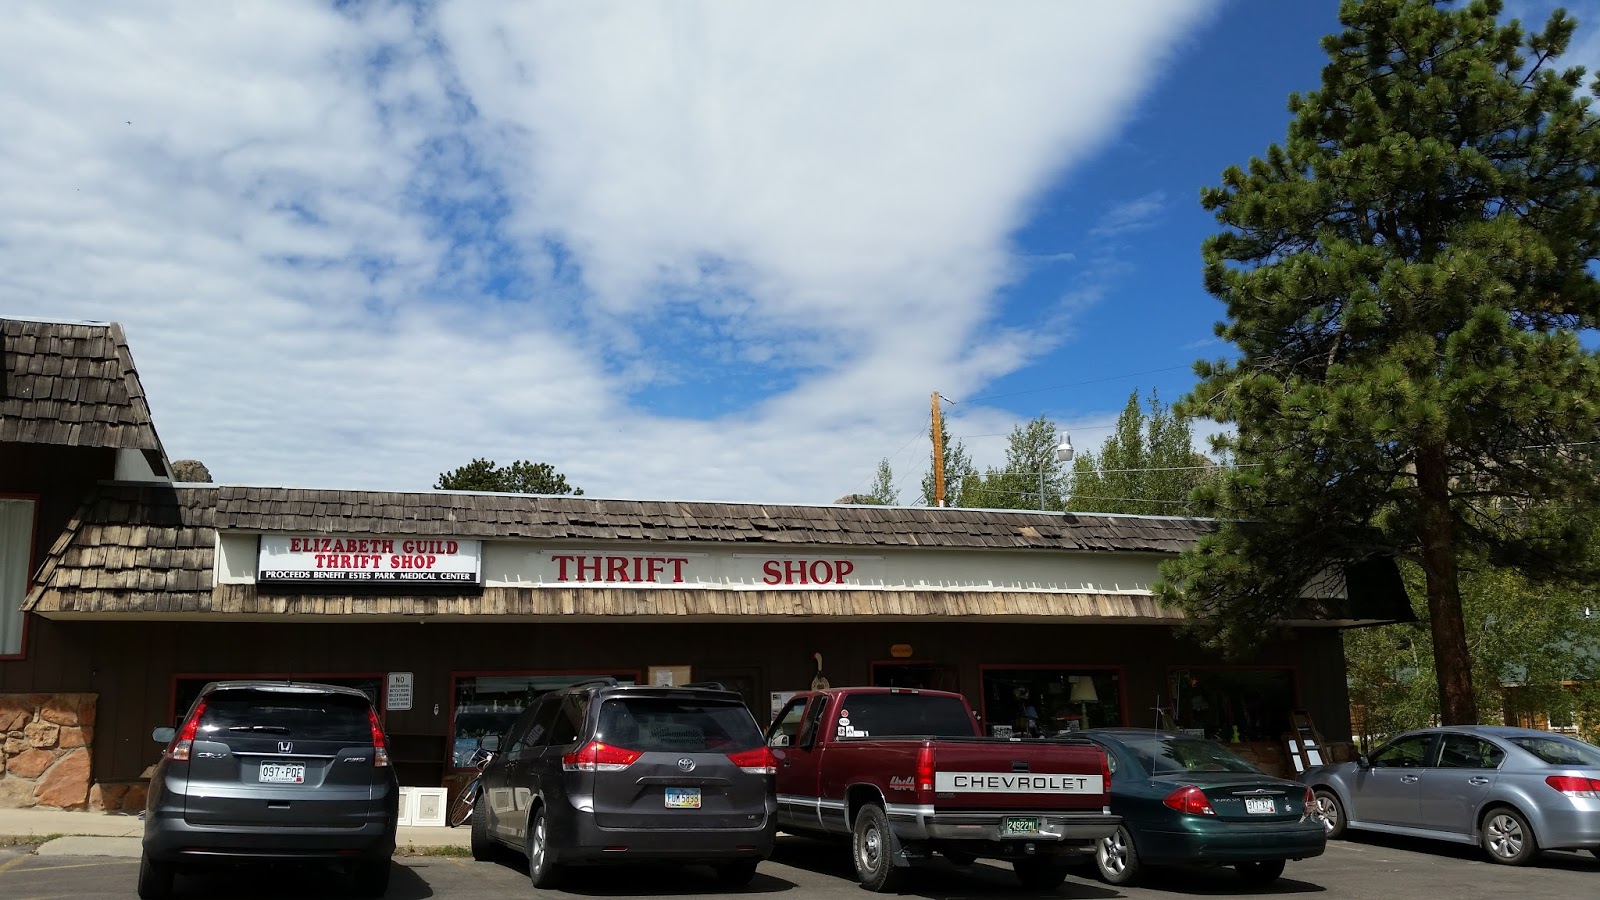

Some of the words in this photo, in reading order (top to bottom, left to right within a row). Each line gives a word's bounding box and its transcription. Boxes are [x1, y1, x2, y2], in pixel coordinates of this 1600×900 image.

[290, 538, 394, 554] ELIZABETH
[402, 540, 458, 555] GUILD
[315, 554, 382, 568] THRIFT
[390, 555, 436, 569] SHOP
[313, 571, 346, 579] BENEFIT
[348, 572, 371, 580] ESTES
[374, 572, 395, 580] PARK
[400, 572, 436, 580] MEDICAL
[440, 572, 470, 580] CENTER
[551, 555, 689, 583] THRIFT
[763, 560, 854, 584] SHOP
[954, 776, 1088, 790] CHEVROLET
